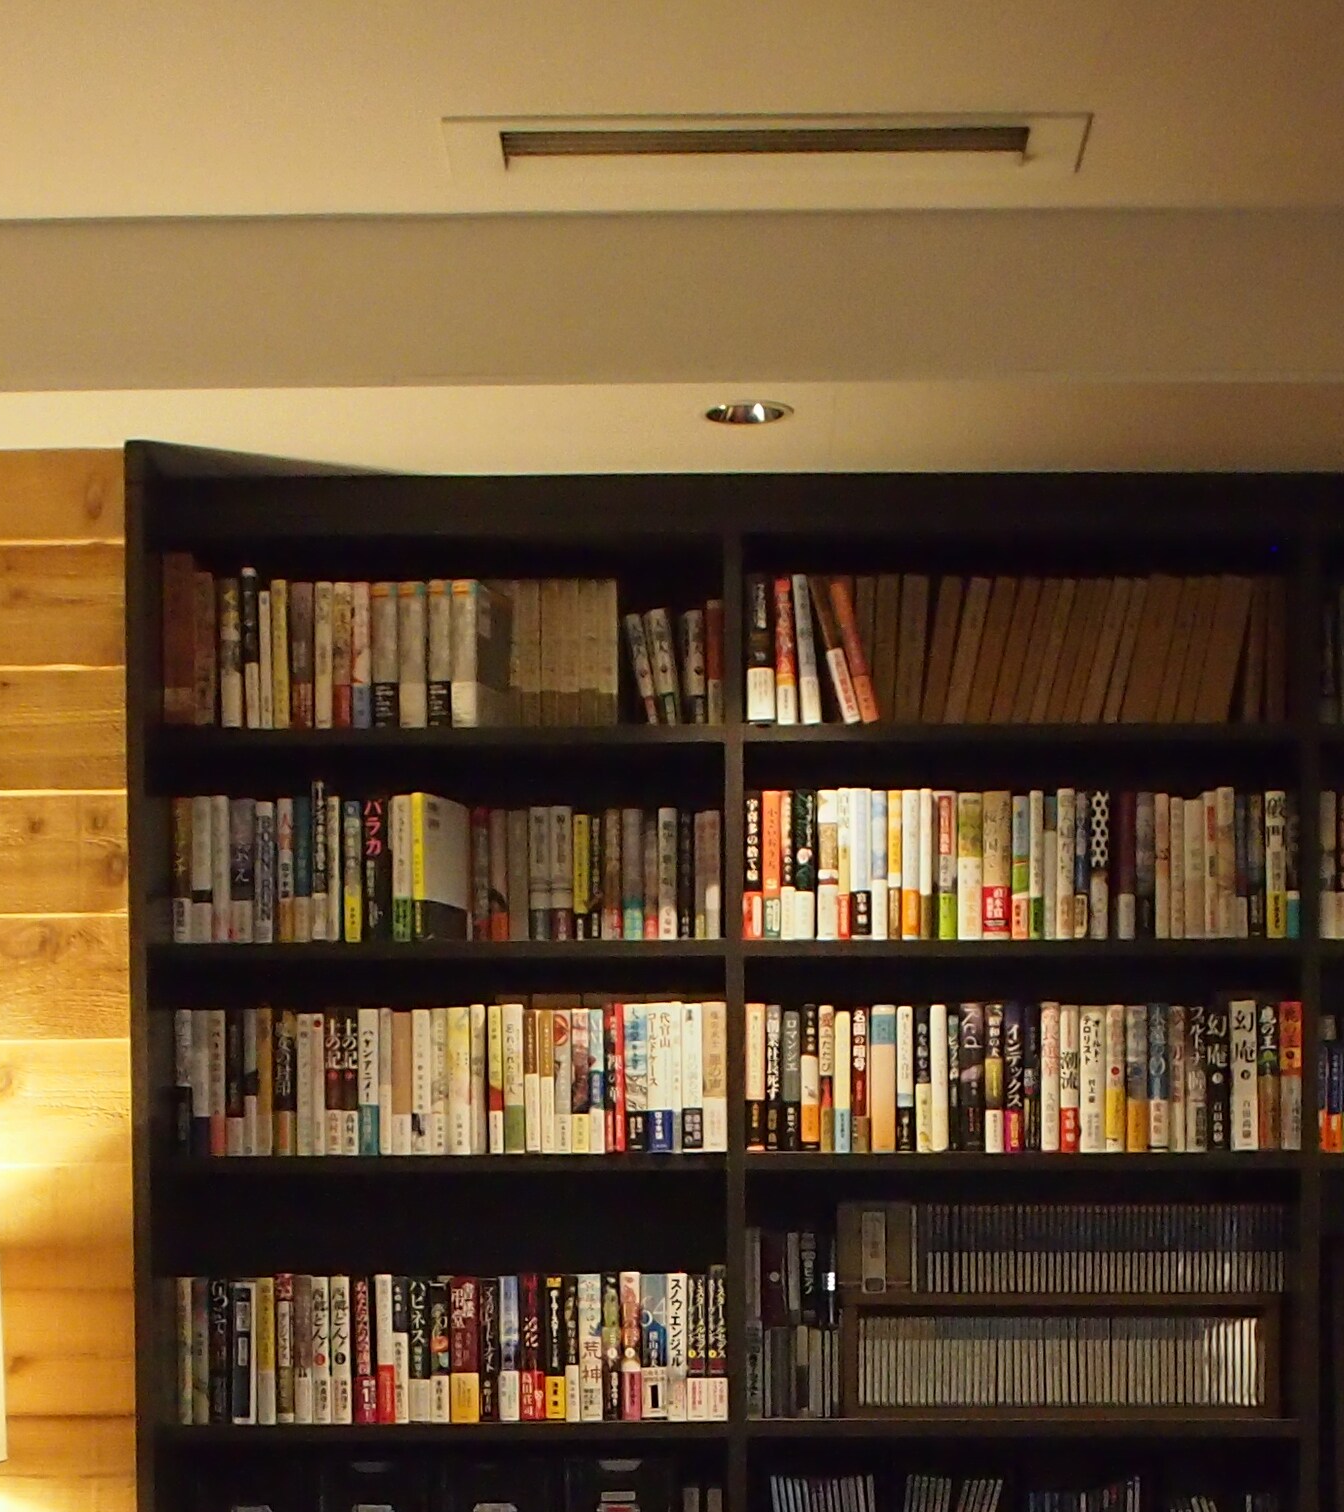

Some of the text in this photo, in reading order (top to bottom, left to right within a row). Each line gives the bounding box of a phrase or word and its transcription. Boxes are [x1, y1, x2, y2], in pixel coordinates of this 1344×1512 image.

[648, 1012, 659, 1087] コールドケース
[410, 1281, 426, 1344] ハピネス
[670, 1279, 684, 1367] スノウ・エンジェル
[583, 1341, 602, 1384] 荒神
